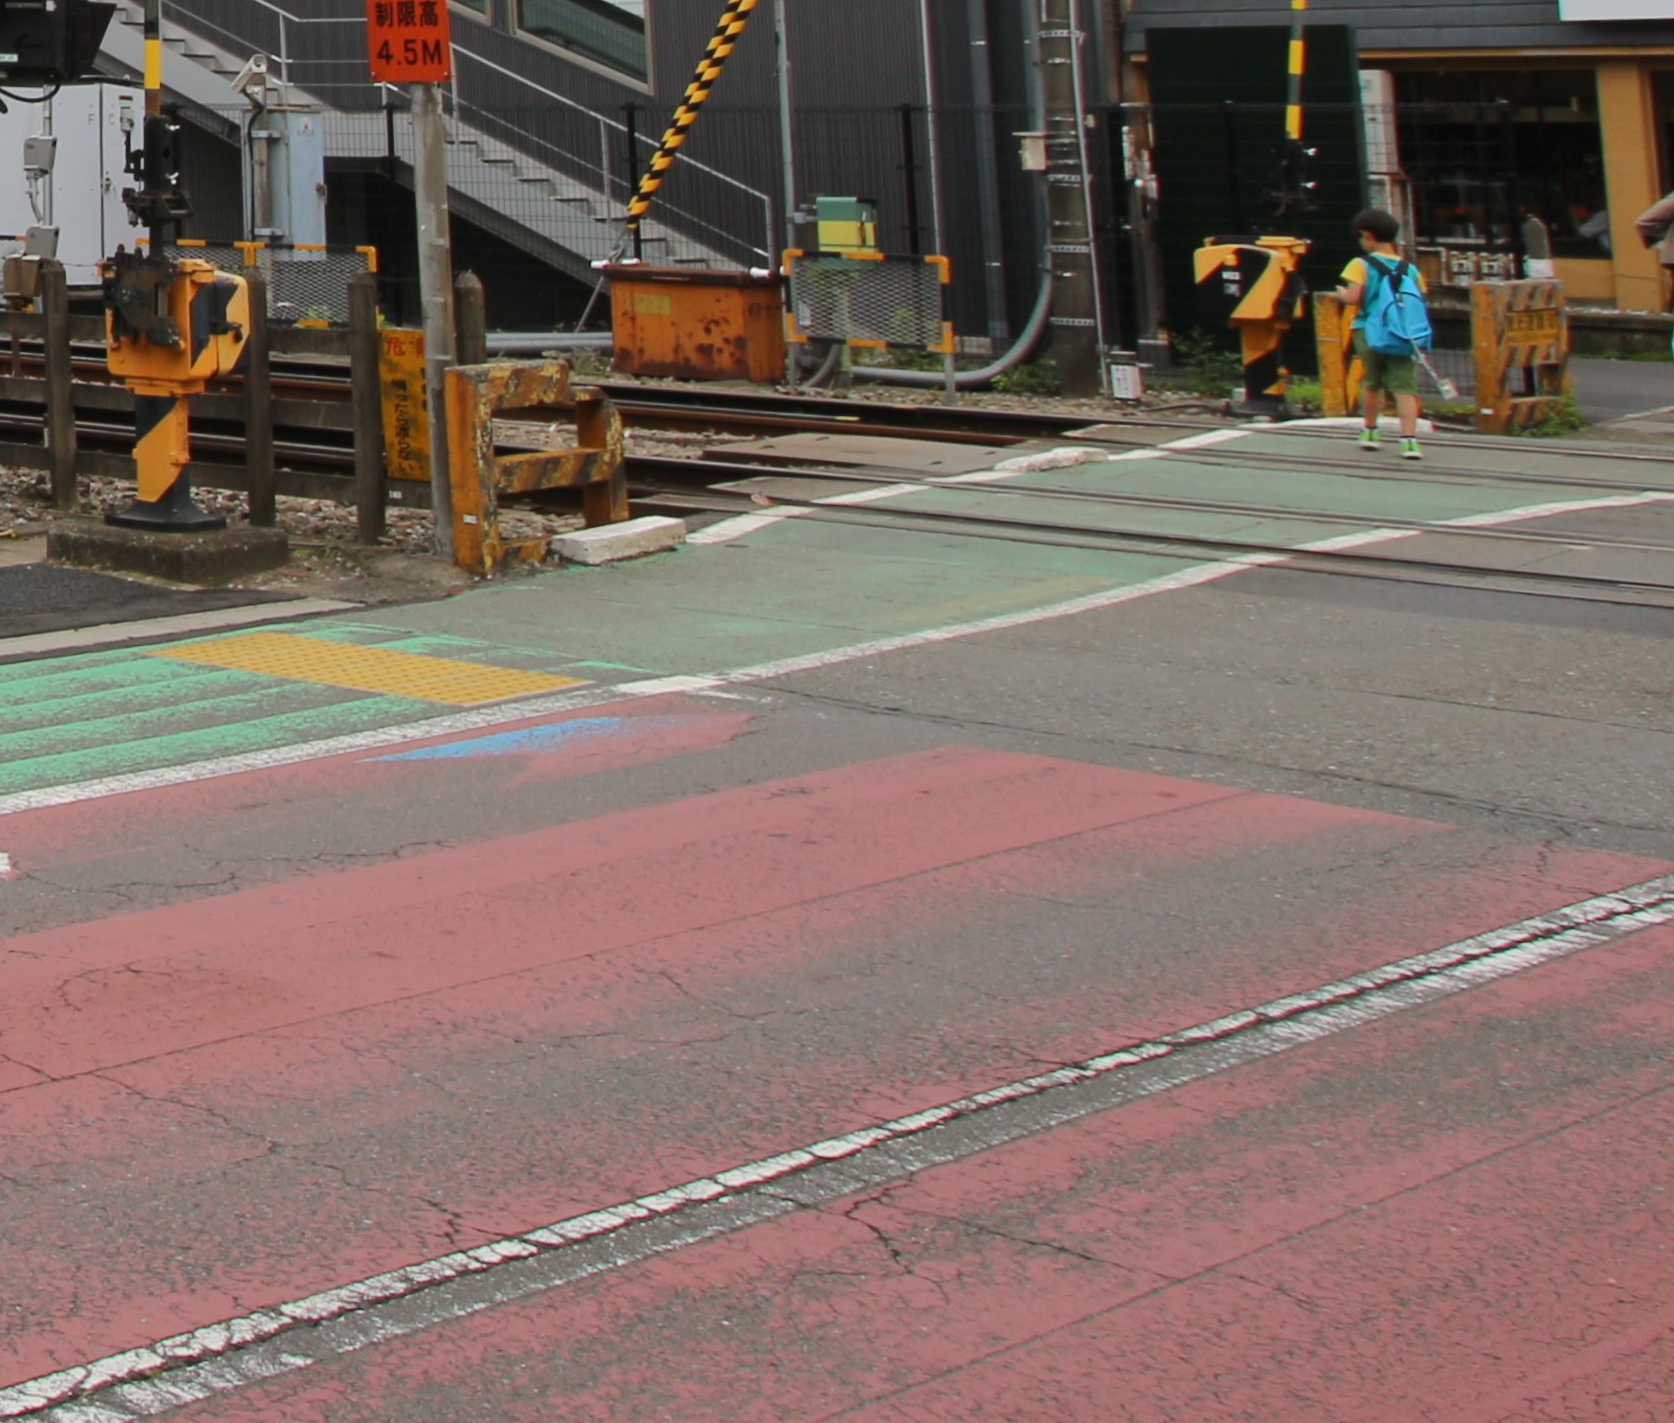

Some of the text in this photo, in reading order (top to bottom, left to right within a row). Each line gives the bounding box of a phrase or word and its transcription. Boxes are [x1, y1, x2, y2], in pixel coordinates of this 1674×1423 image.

[375, 0, 439, 28] 制限高
[377, 38, 443, 66] 4.5M
